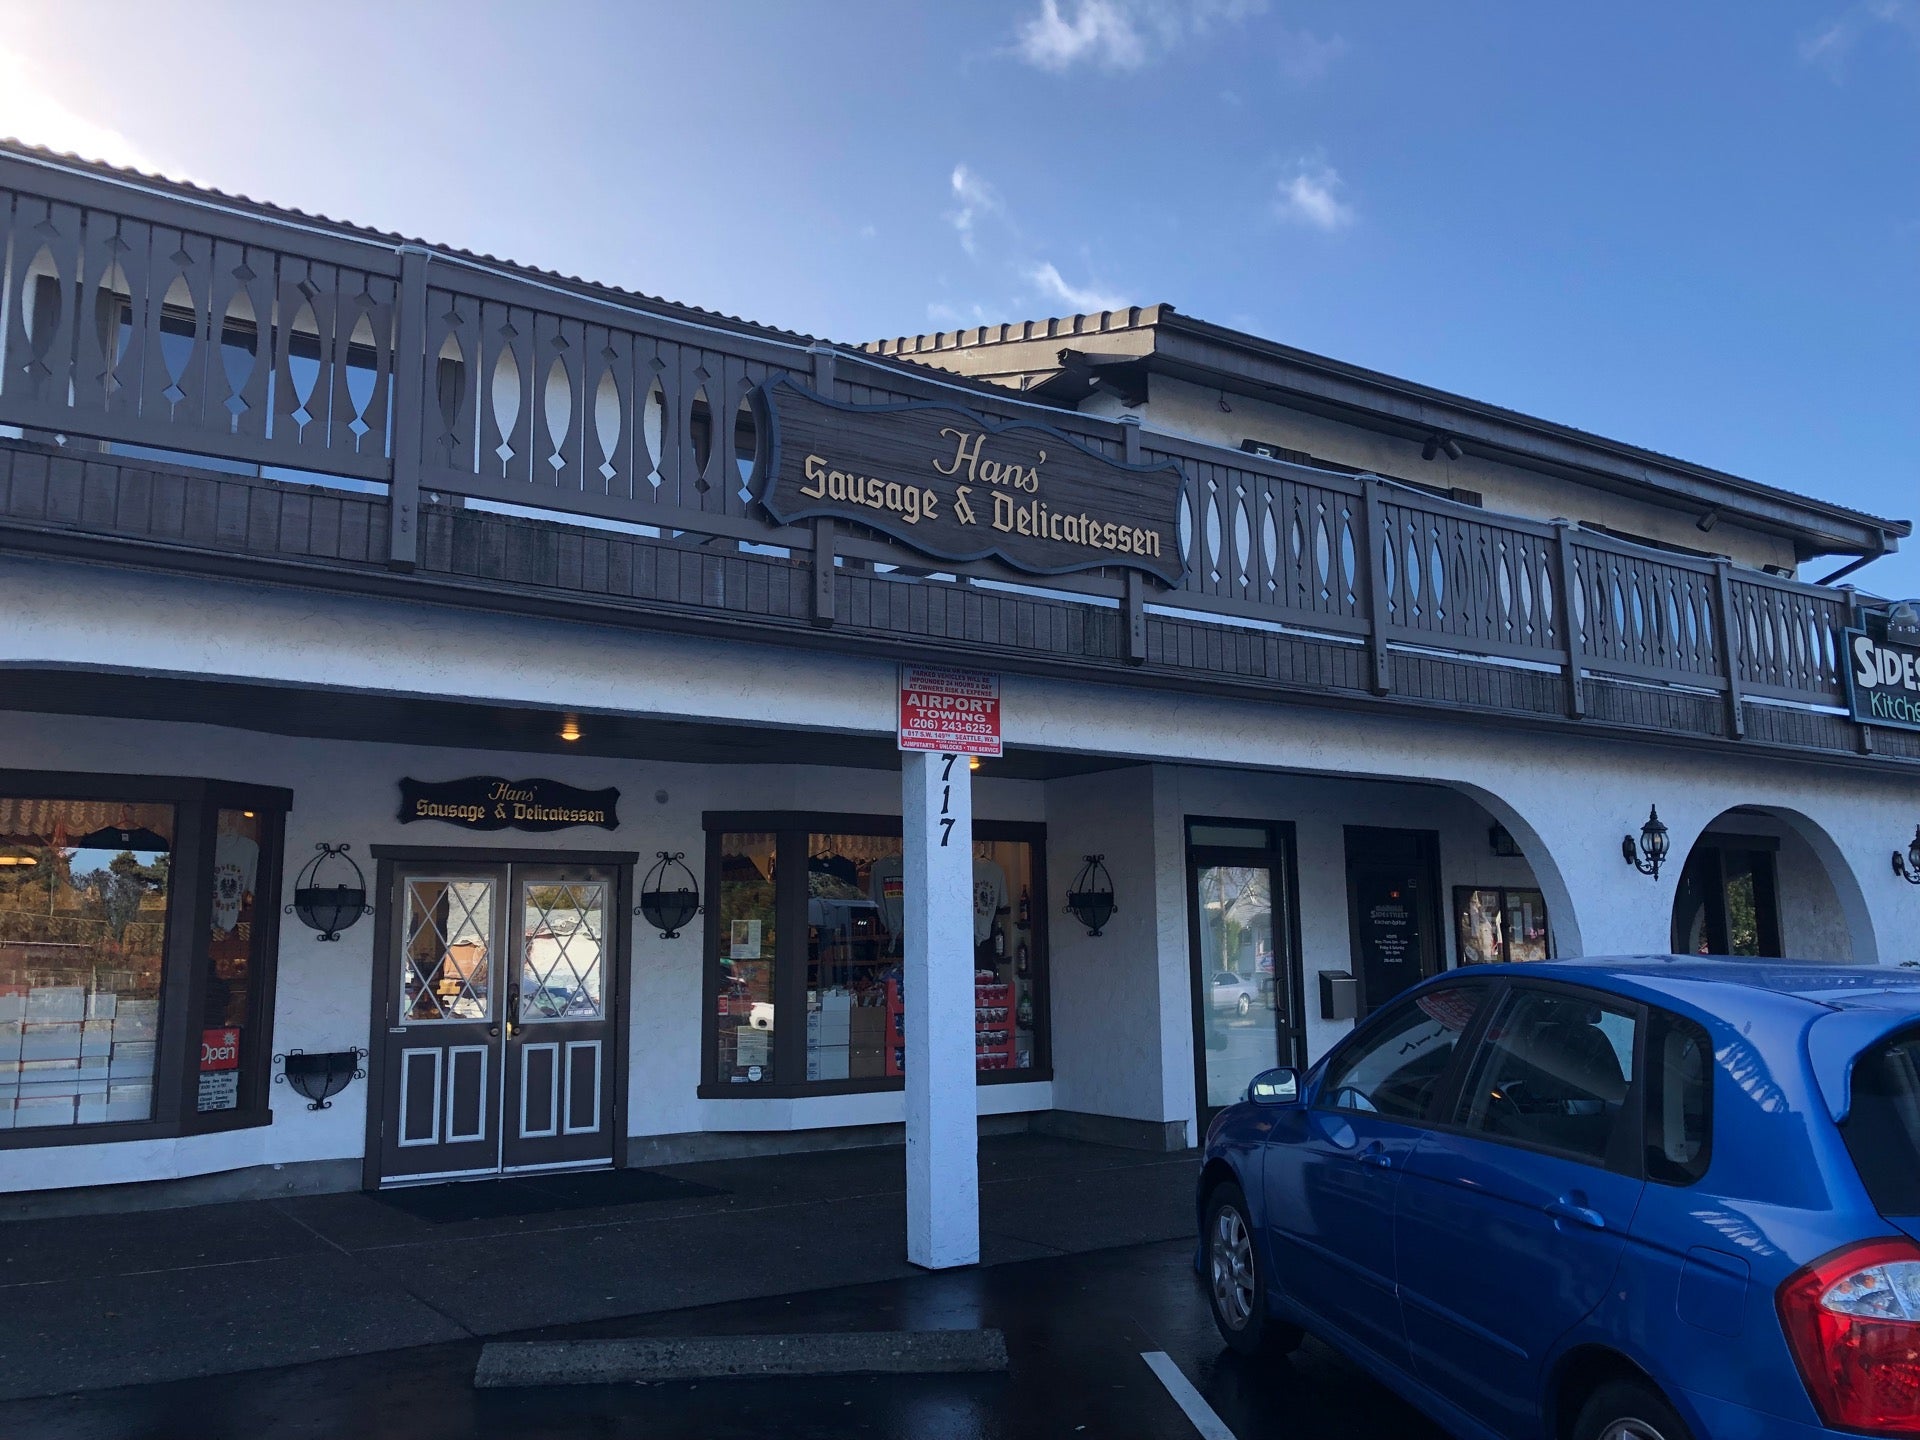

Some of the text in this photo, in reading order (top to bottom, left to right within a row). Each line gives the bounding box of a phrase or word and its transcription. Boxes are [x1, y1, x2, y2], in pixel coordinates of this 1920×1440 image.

[932, 427, 1047, 493] Hans'
[800, 453, 1161, 558] Sausage & Delicatessen
[909, 676, 945, 685] IMPOUNDED
[906, 693, 995, 713] AIRPORT
[916, 708, 986, 722] TOWING
[909, 718, 992, 734] (206) 243-6252
[487, 782, 538, 802] Hans'
[416, 799, 605, 822] Sausage & Delicatessen
[201, 1043, 235, 1065] Open
